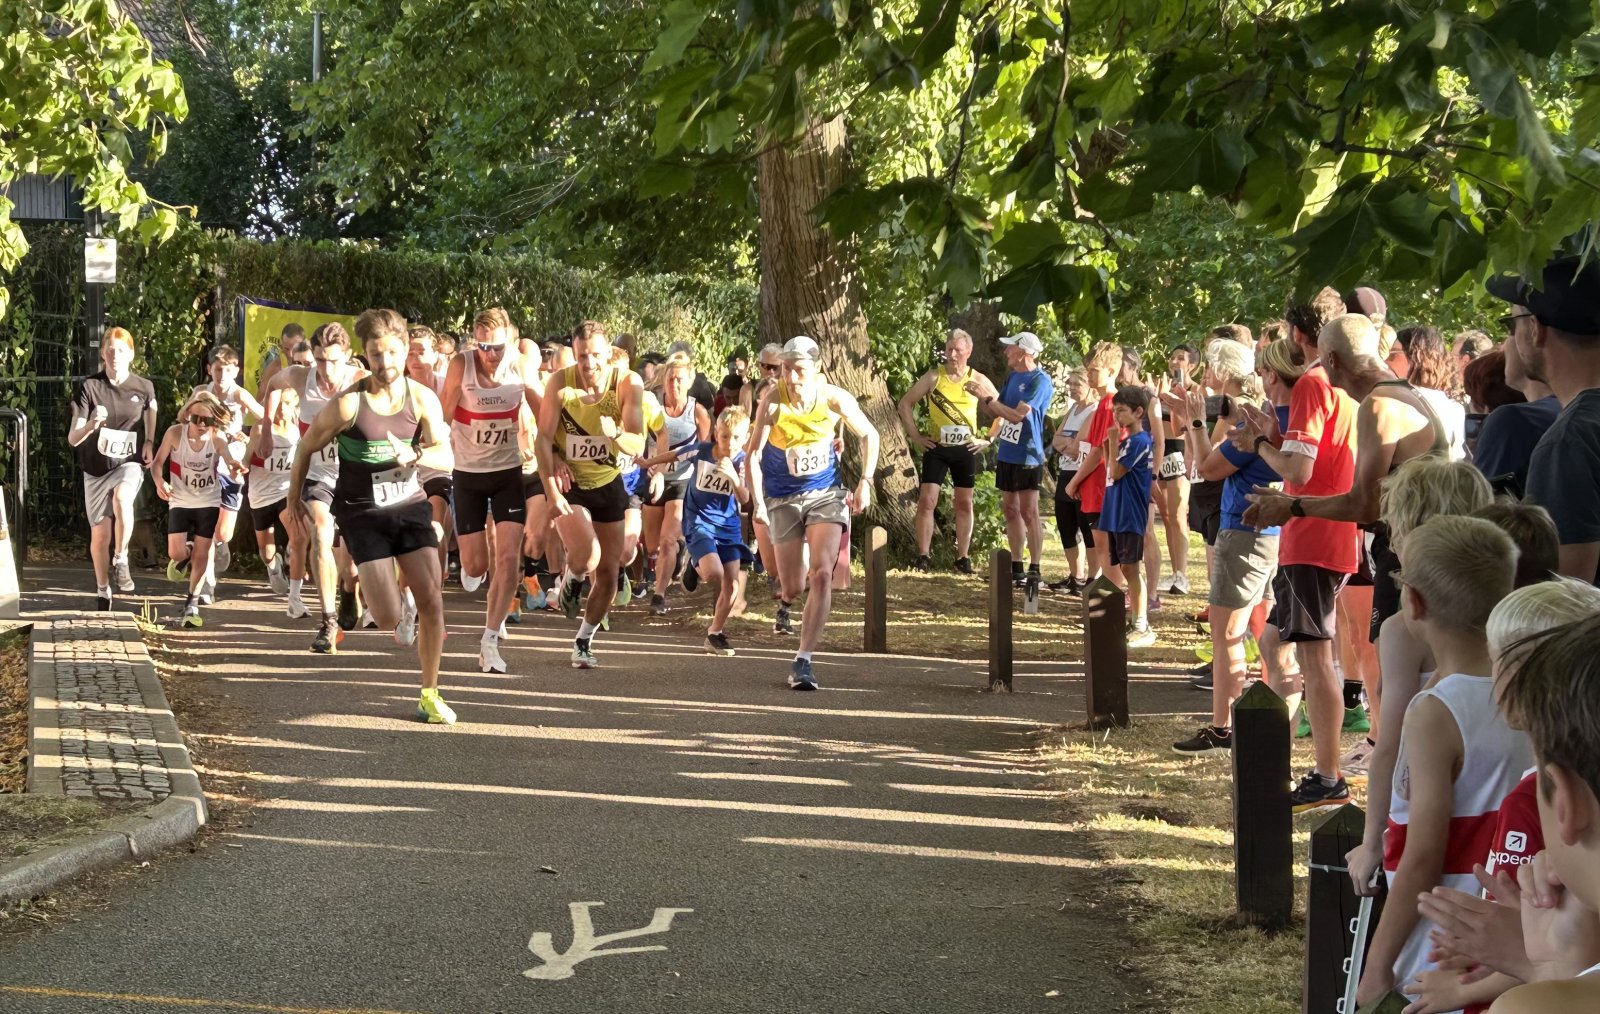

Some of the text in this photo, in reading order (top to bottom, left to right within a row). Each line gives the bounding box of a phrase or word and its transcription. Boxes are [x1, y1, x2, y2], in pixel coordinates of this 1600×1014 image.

[476, 430, 508, 445] 127A
[572, 443, 607, 458] 120A
[270, 458, 292, 472] 142
[185, 475, 214, 488] 140A
